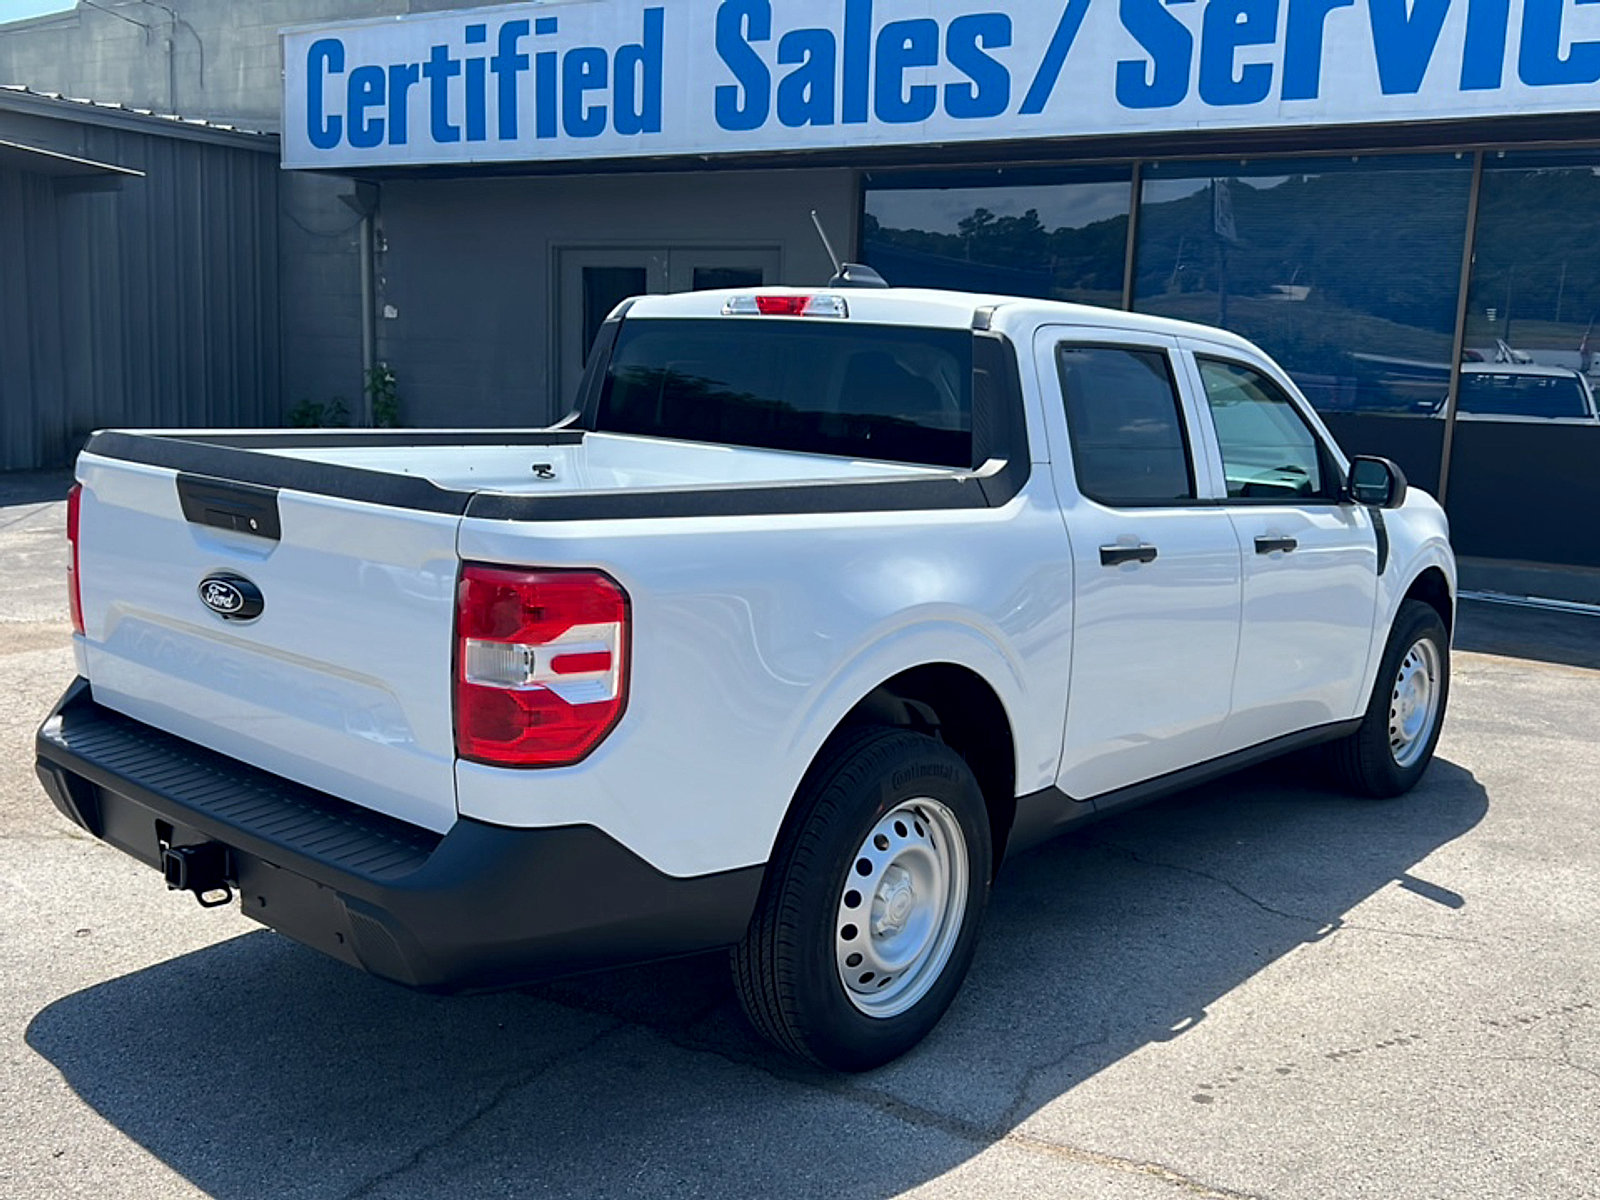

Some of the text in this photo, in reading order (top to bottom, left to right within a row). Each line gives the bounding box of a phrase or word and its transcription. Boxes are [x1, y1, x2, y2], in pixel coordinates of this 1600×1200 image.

[307, 7, 664, 150] Certified
[205, 582, 236, 608] Ford
[891, 761, 953, 791] Continental
